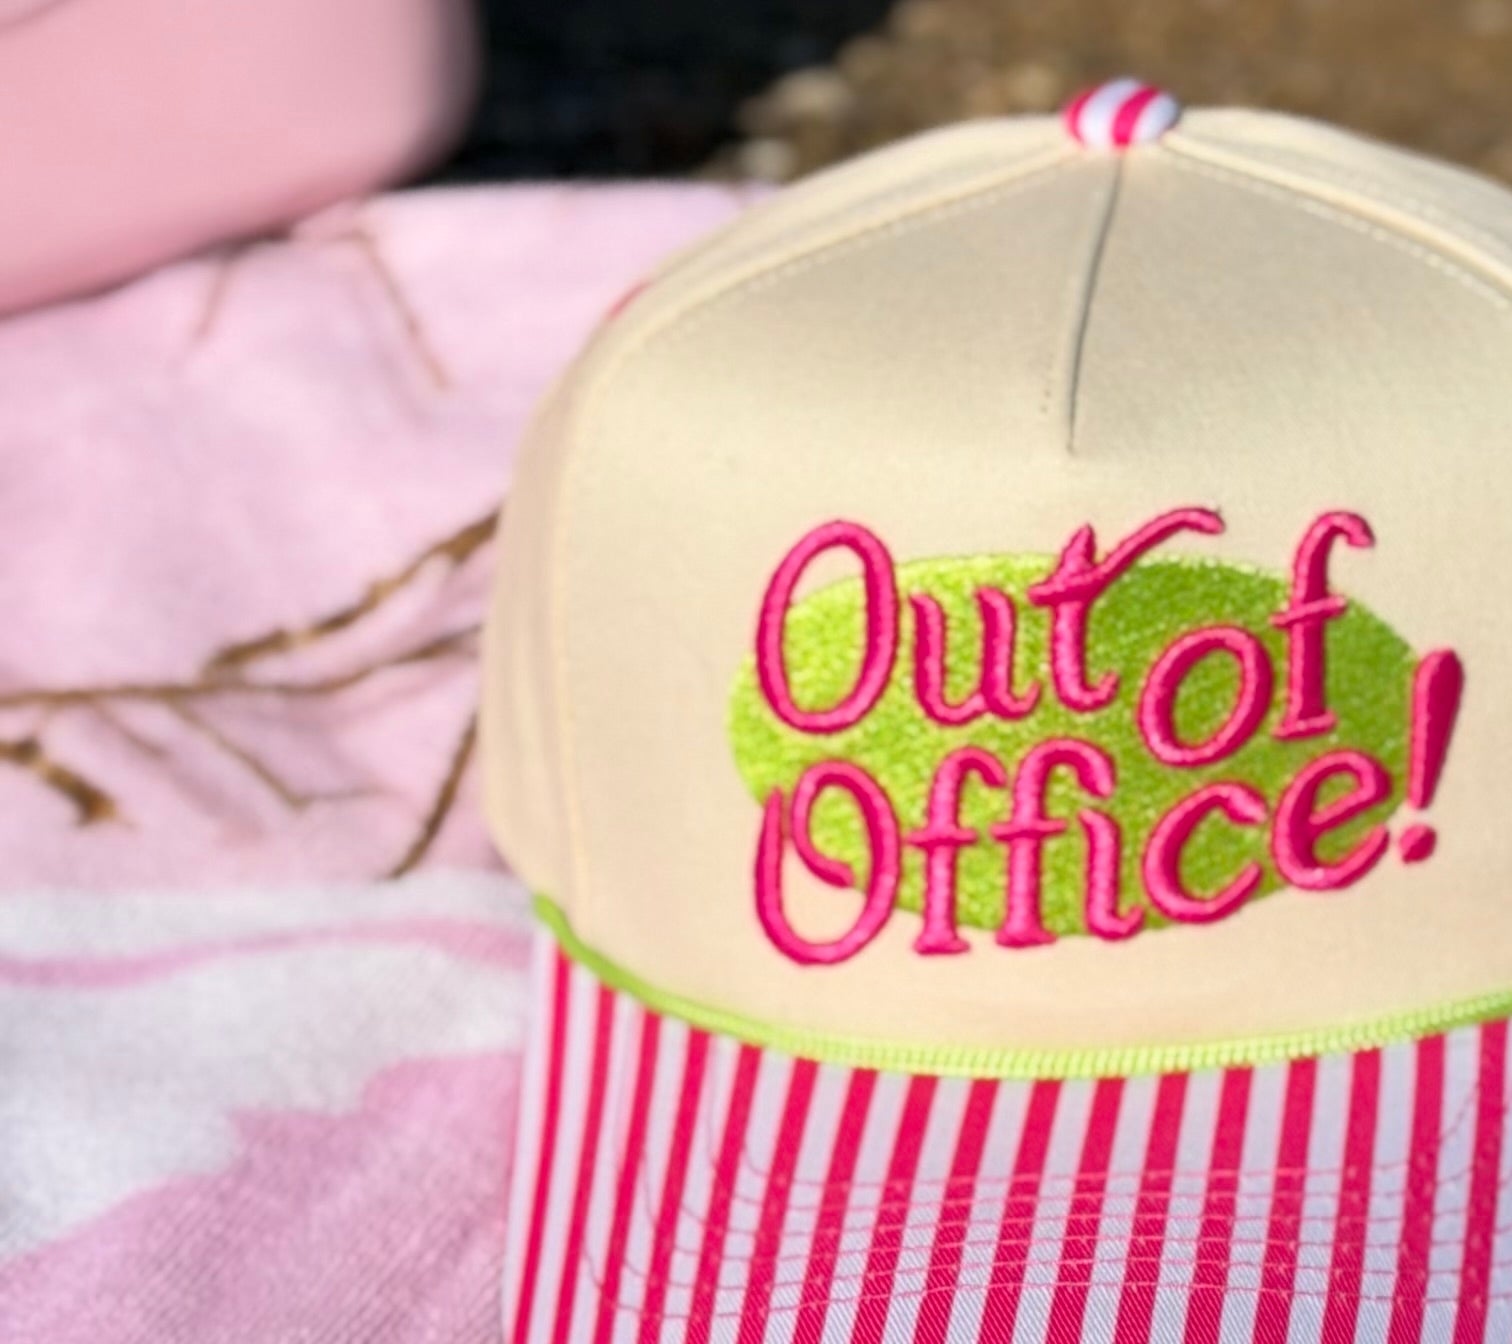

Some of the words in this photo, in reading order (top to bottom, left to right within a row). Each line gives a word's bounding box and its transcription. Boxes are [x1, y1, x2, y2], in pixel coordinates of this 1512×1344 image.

[755, 506, 1225, 735] Out
[1137, 510, 1376, 768] of
[753, 647, 1466, 967] Office!
